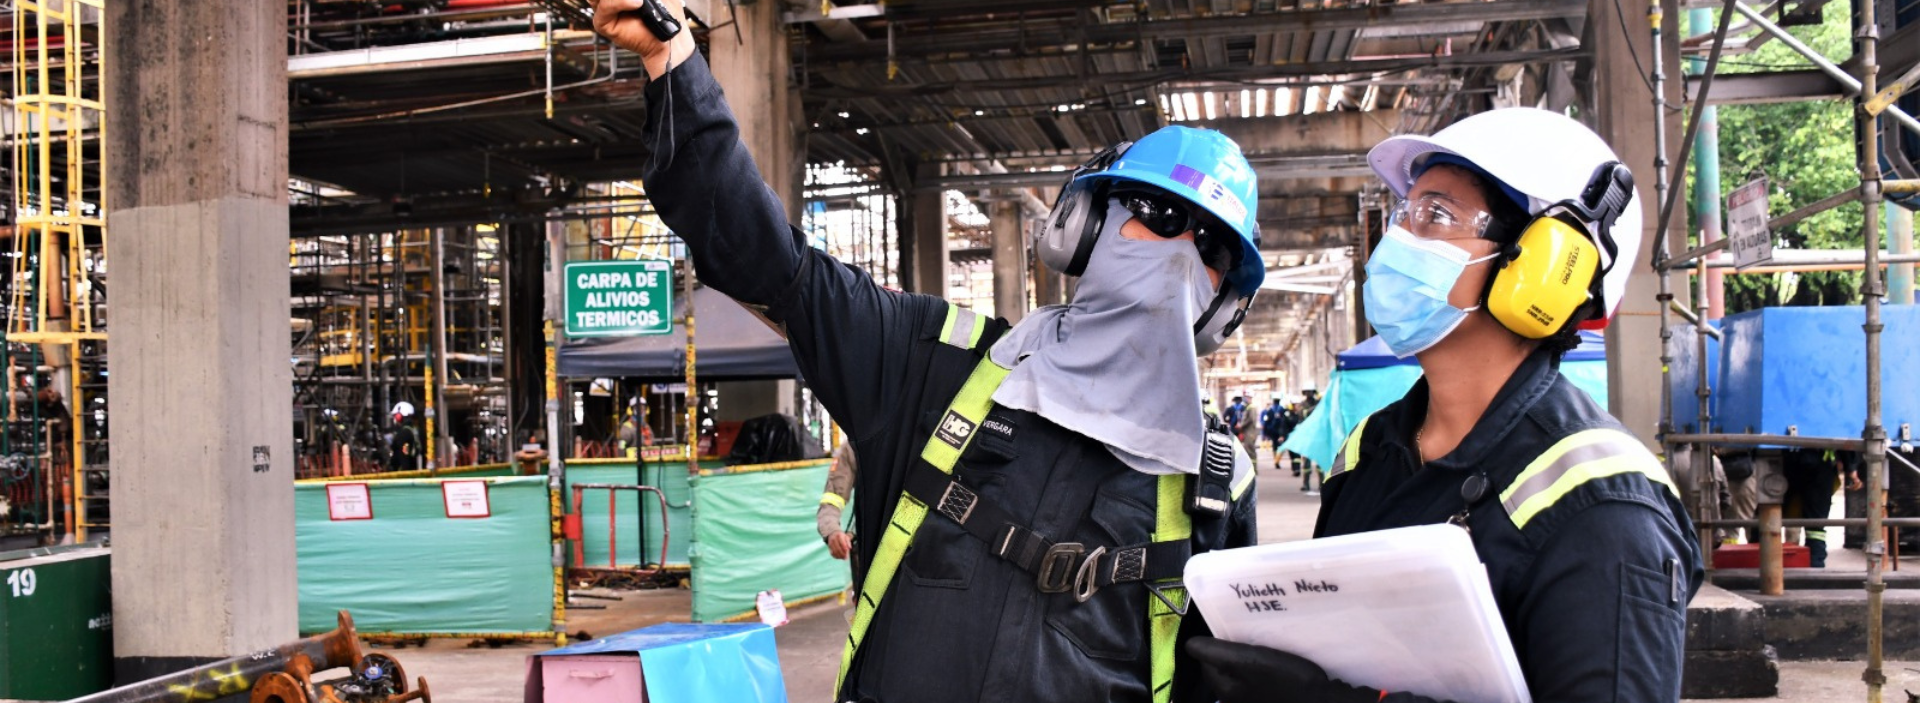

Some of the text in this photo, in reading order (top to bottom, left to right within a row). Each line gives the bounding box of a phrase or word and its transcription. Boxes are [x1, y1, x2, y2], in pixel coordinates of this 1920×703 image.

[1562, 246, 1580, 286] STEELPRO
[577, 271, 658, 289] CARPA DE
[585, 291, 650, 308] ALIVIOS
[576, 309, 660, 327] TERMICOS
[982, 420, 1013, 436] VERGARA
[7, 568, 36, 597] 19
[1294, 579, 1339, 593] Nieto
